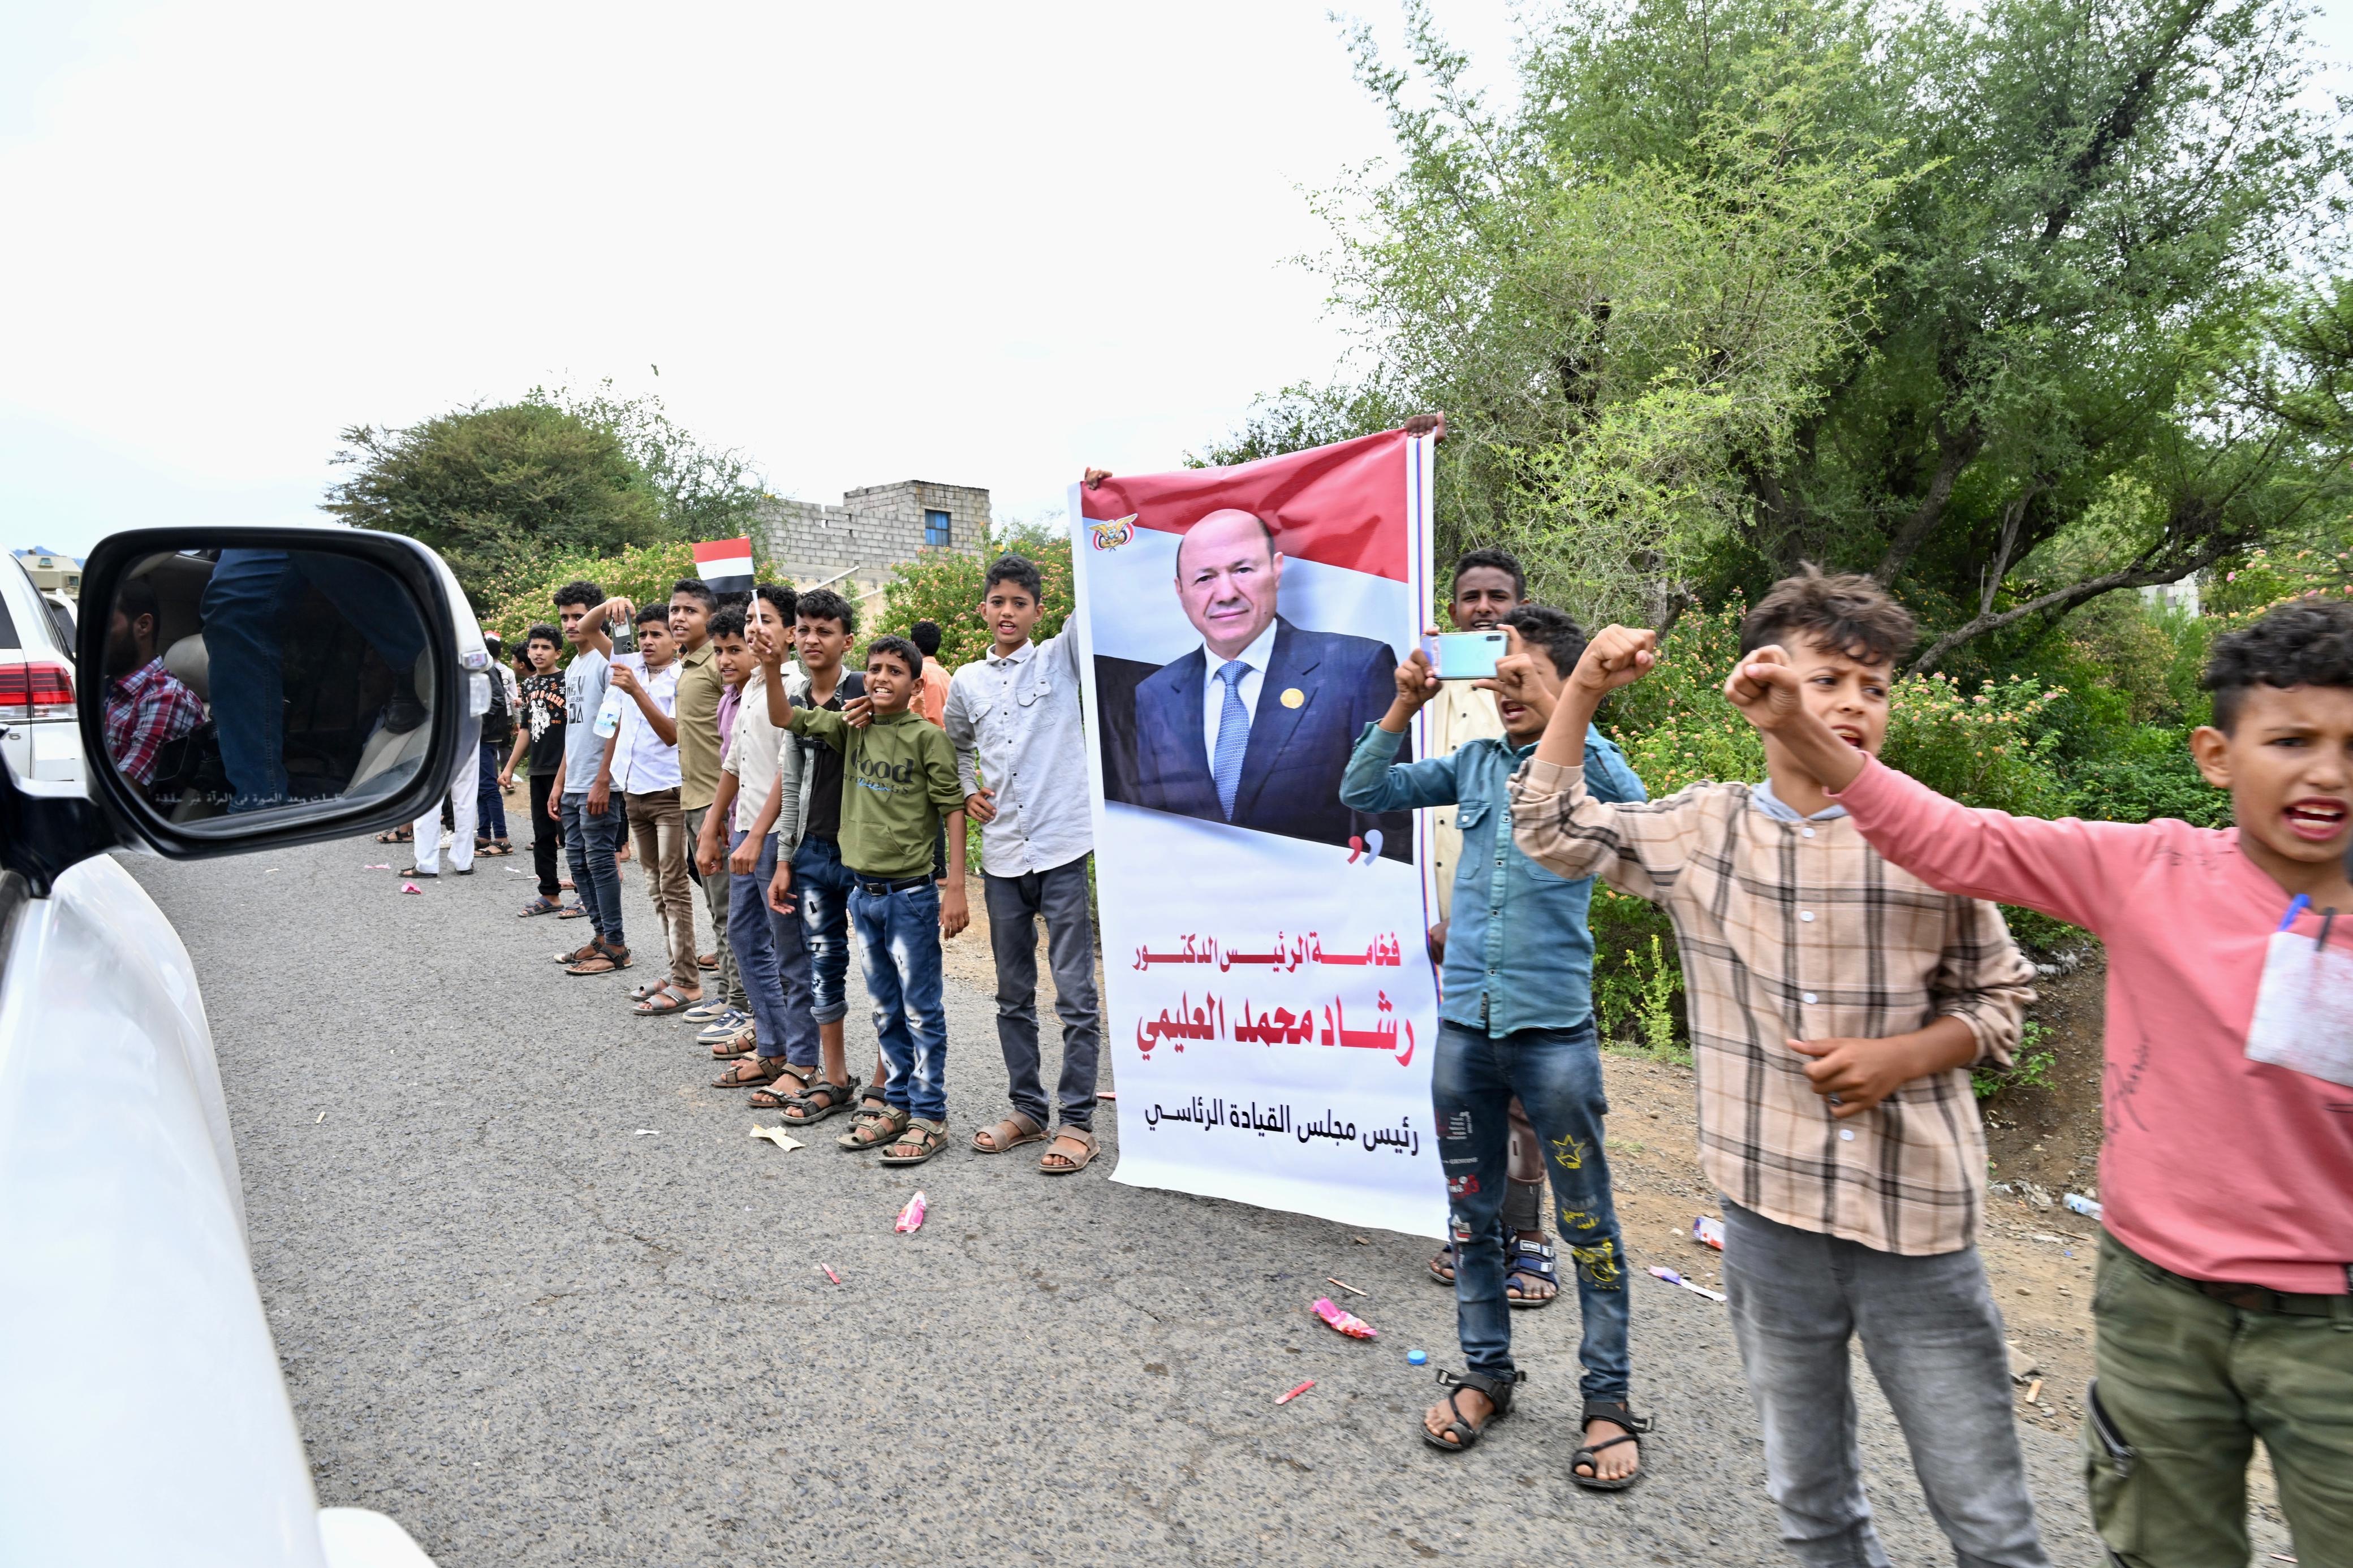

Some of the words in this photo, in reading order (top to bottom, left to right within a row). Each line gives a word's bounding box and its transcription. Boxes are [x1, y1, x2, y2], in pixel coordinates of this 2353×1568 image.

[1132, 933, 1218, 971] الدكتور
[1220, 931, 1311, 973] الرئيس
[1309, 931, 1402, 966] فخامة
[1136, 990, 1225, 1061] العليمي
[1234, 997, 1313, 1047] محمد
[1321, 990, 1415, 1067] رشاد
[1145, 1096, 1224, 1131] الرئاسي
[1230, 1102, 1290, 1138] القيادة
[1297, 1109, 1356, 1148] مجلس
[1363, 1116, 1418, 1156] رئيس
